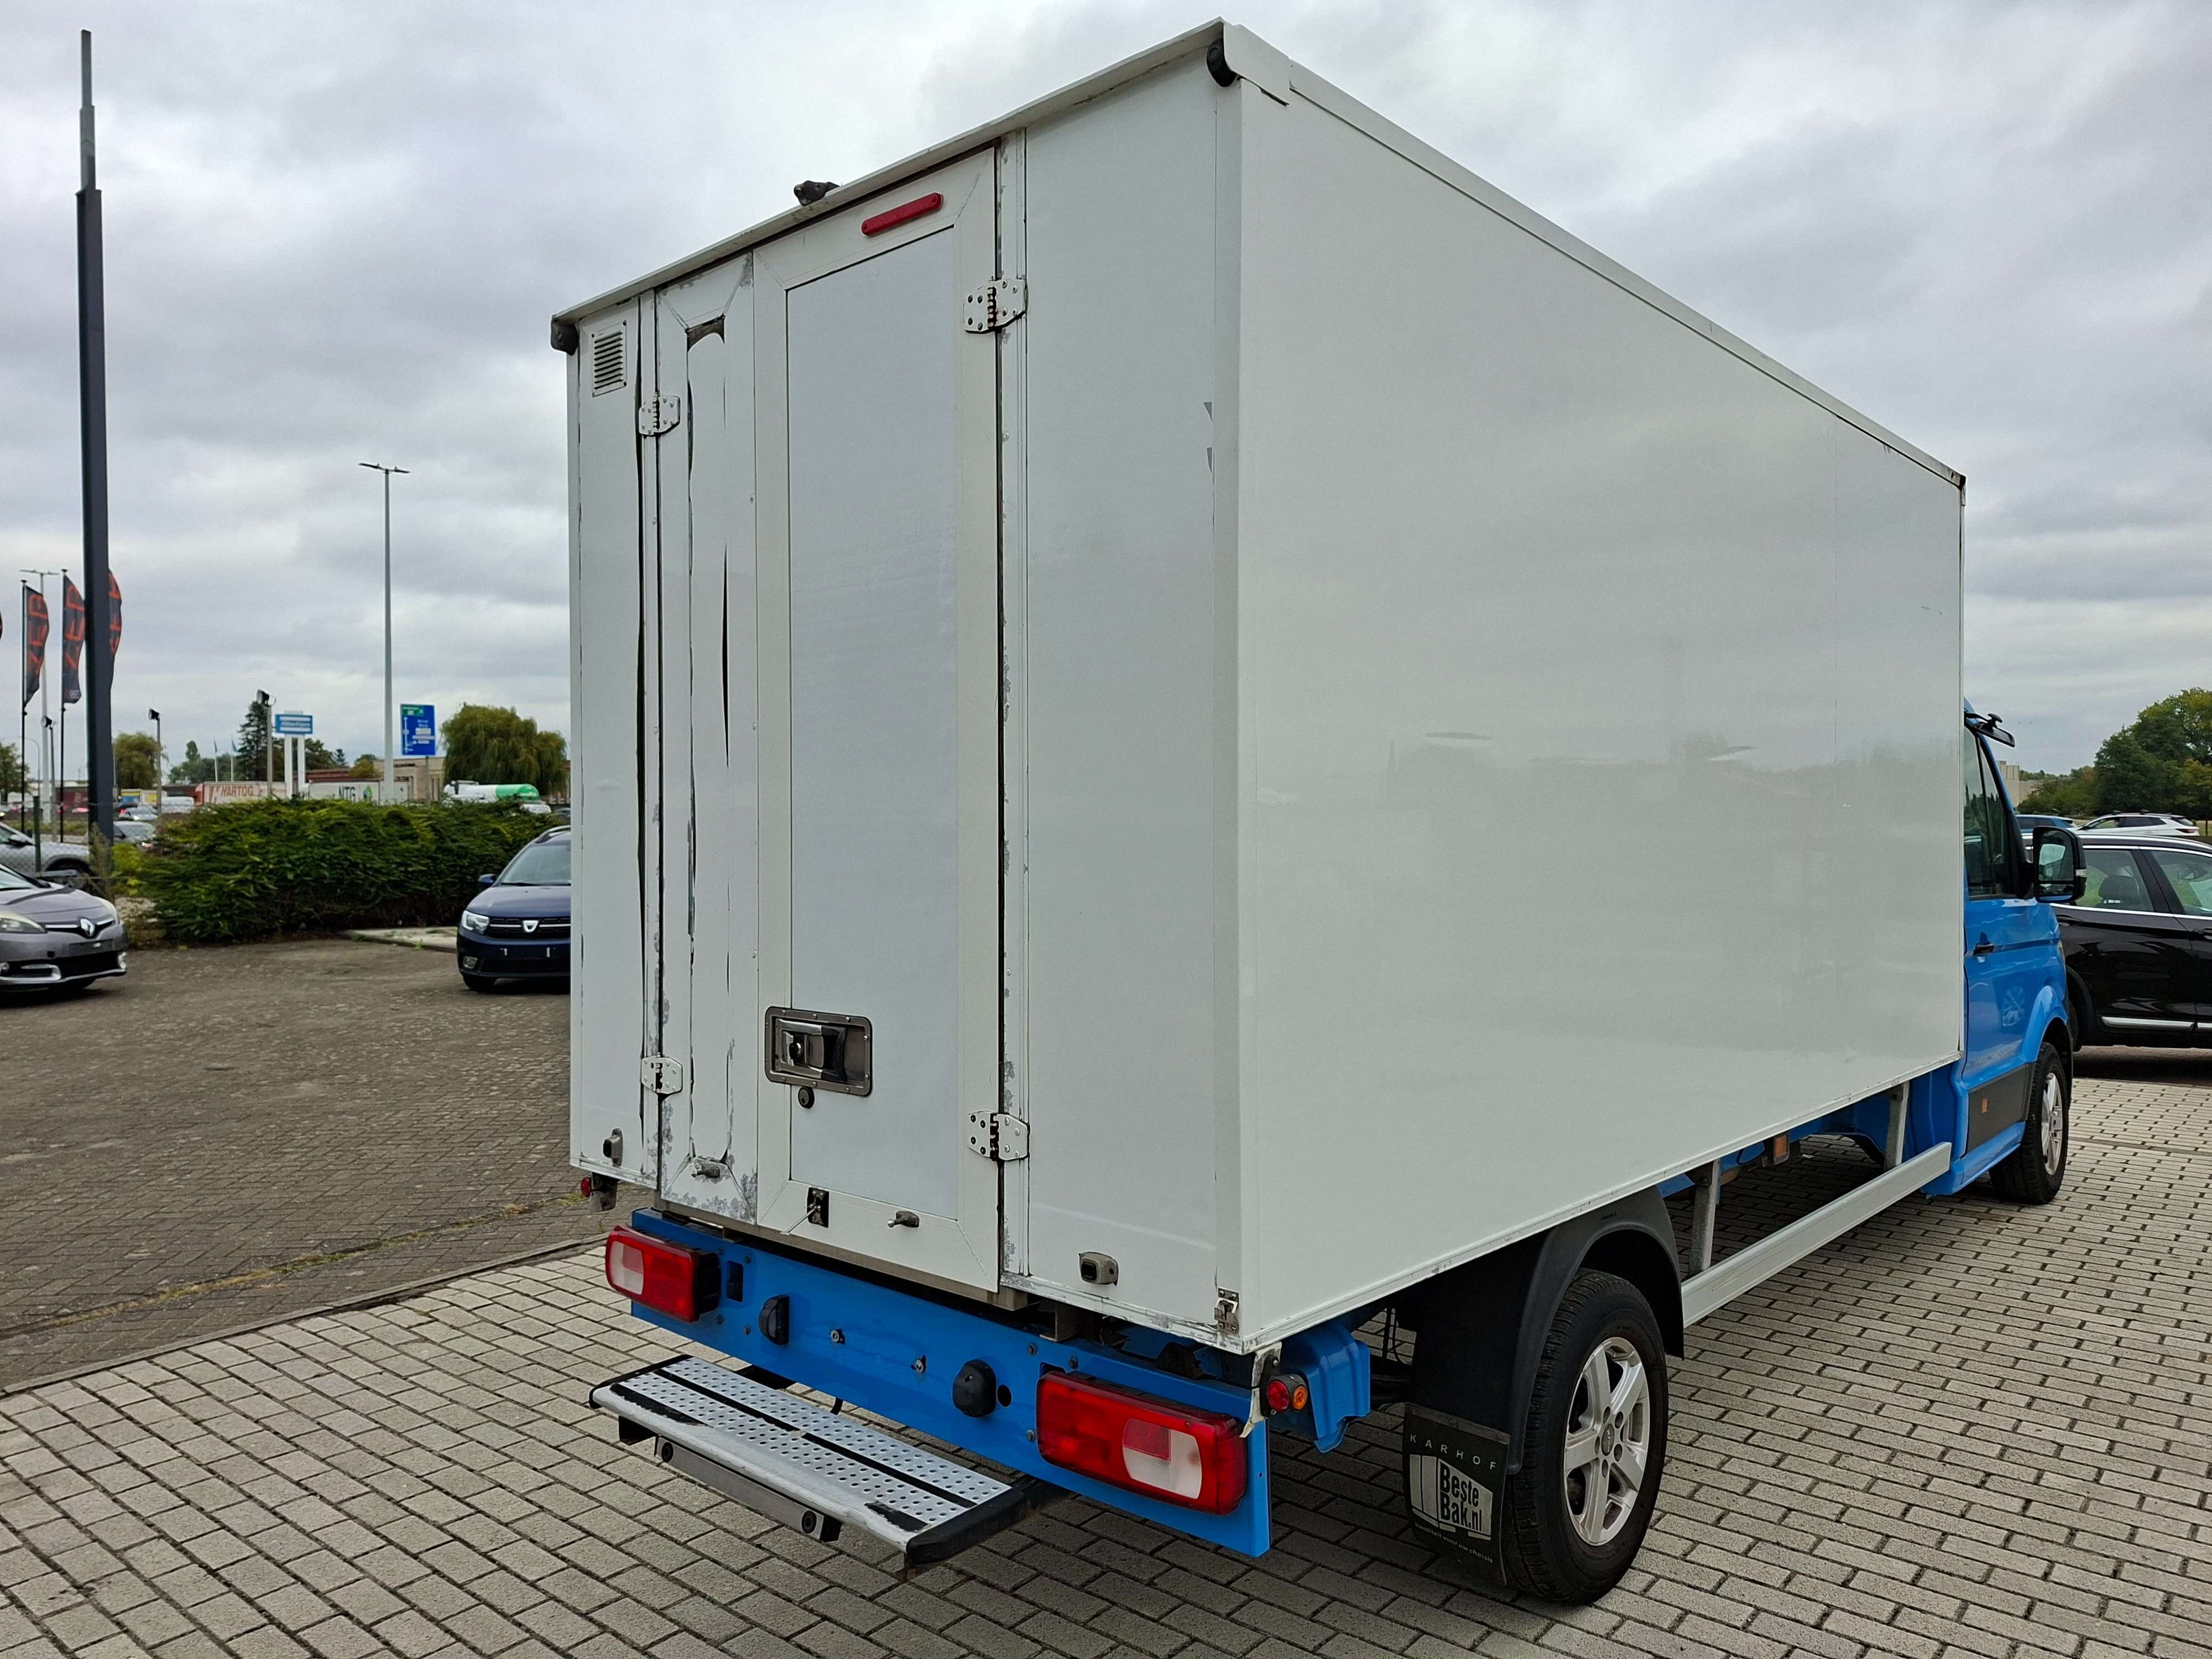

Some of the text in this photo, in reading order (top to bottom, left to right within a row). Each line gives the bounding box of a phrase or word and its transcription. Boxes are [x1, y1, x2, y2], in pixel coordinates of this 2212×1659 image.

[221, 785, 253, 797] HARTOG
[338, 786, 356, 801] NTG
[1410, 1433, 1496, 1470] KARHOF
[1440, 1462, 1479, 1507] Beste
[1440, 1492, 1482, 1532] Bak.nl
[1415, 1521, 1494, 1564] kwaliteit voor uw chassis
